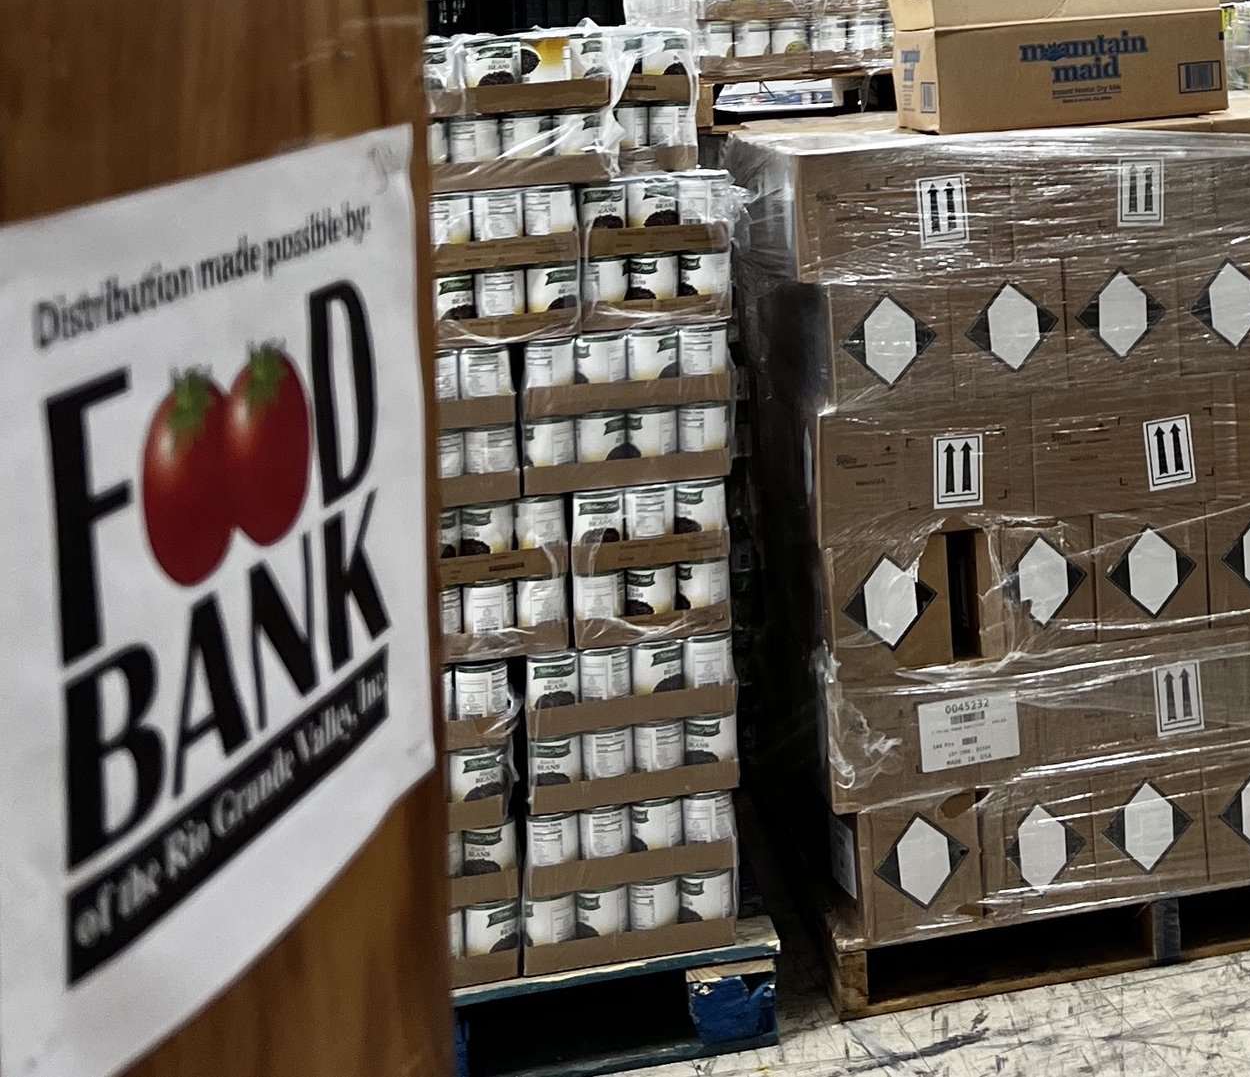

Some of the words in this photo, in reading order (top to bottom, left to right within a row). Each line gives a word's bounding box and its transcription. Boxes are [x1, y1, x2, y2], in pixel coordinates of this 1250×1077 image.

[1019, 29, 1148, 63] mountain
[1051, 54, 1122, 84] maid
[33, 261, 194, 350] Distribution
[196, 234, 261, 292] made
[262, 206, 342, 280] possible
[64, 487, 392, 872] BANK
[944, 698, 990, 715] 0045232
[73, 880, 115, 948] of
[116, 857, 161, 918] the
[163, 818, 210, 880] Rio
[211, 746, 295, 838] Grande
